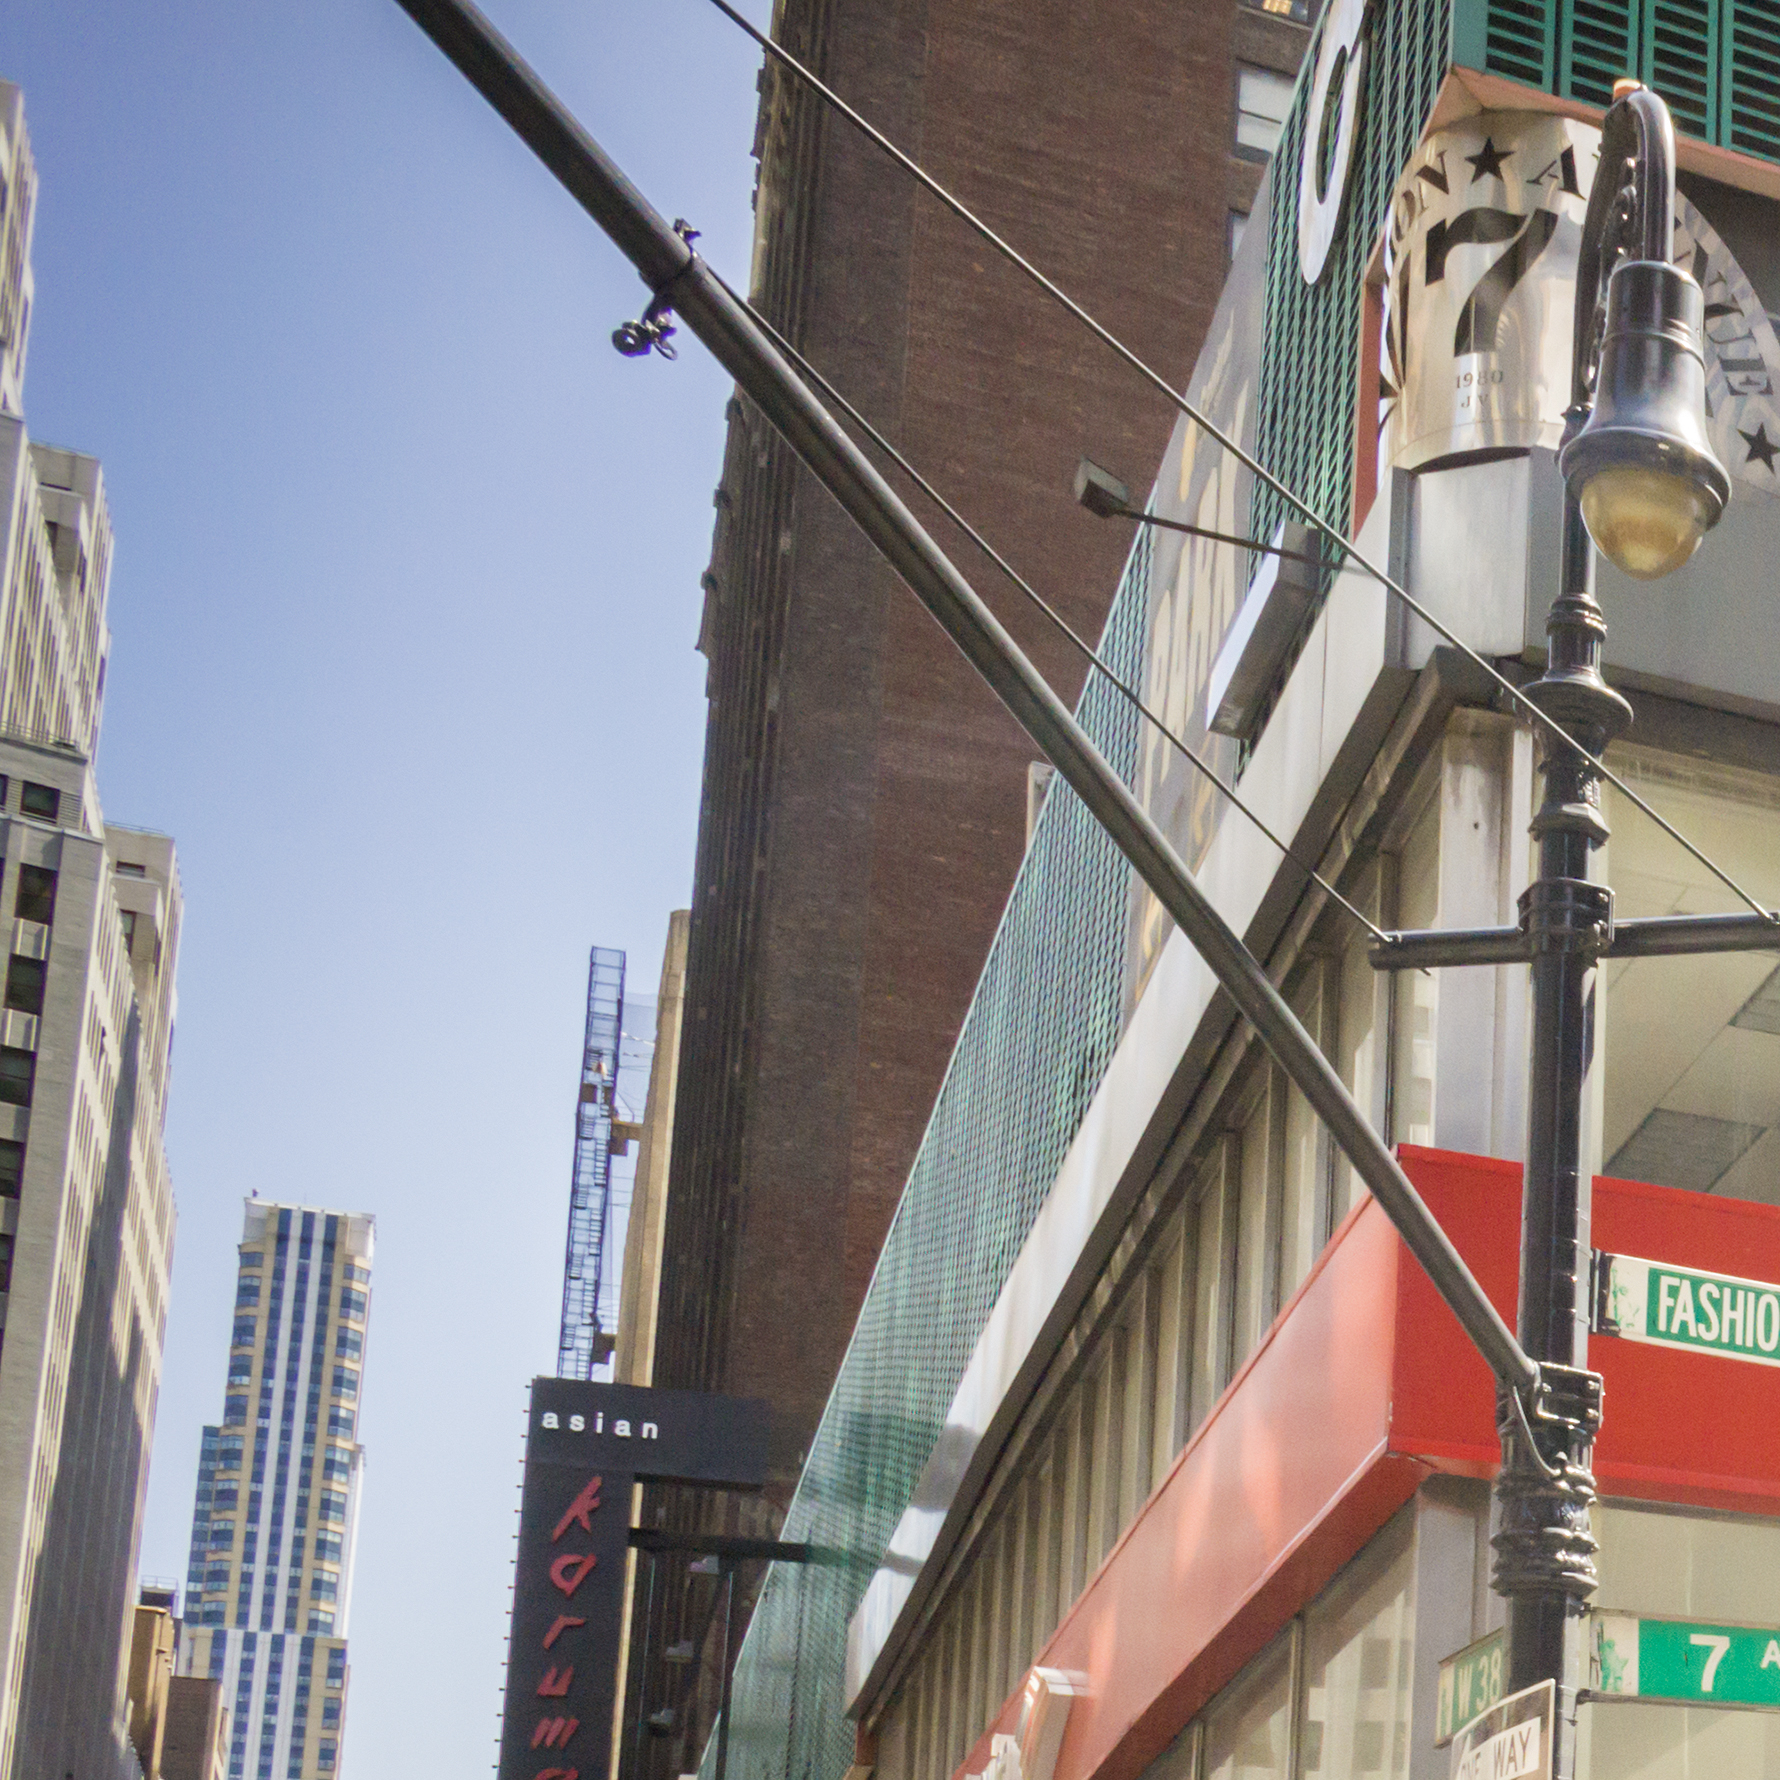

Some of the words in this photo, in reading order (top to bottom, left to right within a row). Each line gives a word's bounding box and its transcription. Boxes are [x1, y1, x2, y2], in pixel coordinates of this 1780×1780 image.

[1425, 206, 1559, 358] 7
[1455, 370, 1504, 391] 1980
[541, 1409, 659, 1440] asian
[1458, 1664, 1473, 1721] W
[1476, 1648, 1502, 1712] 38
[1690, 1634, 1729, 1692] 7
[1493, 1727, 1532, 1780] WAY
